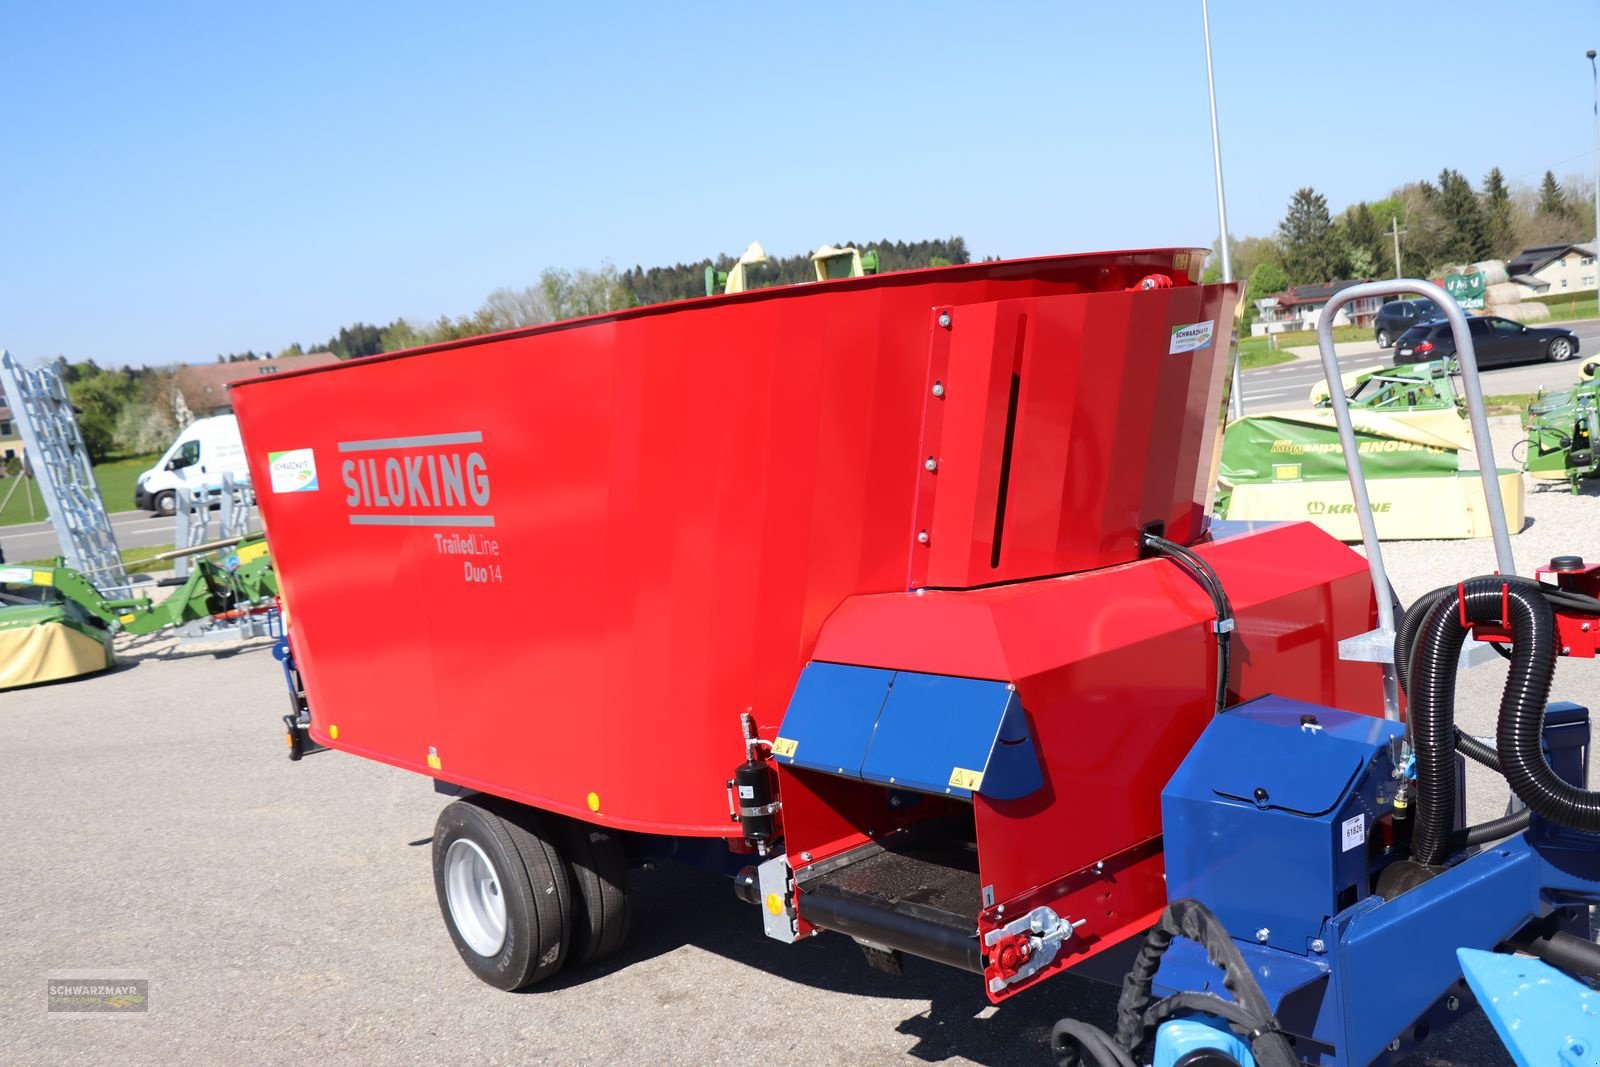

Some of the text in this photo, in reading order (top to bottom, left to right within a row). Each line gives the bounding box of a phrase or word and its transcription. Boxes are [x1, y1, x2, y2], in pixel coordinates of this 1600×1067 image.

[342, 452, 490, 507] SILOKING
[1327, 503, 1392, 514] KRNE
[433, 533, 499, 556] TrailedLine
[464, 561, 503, 583] Duo 14
[1347, 823, 1363, 837] 61826
